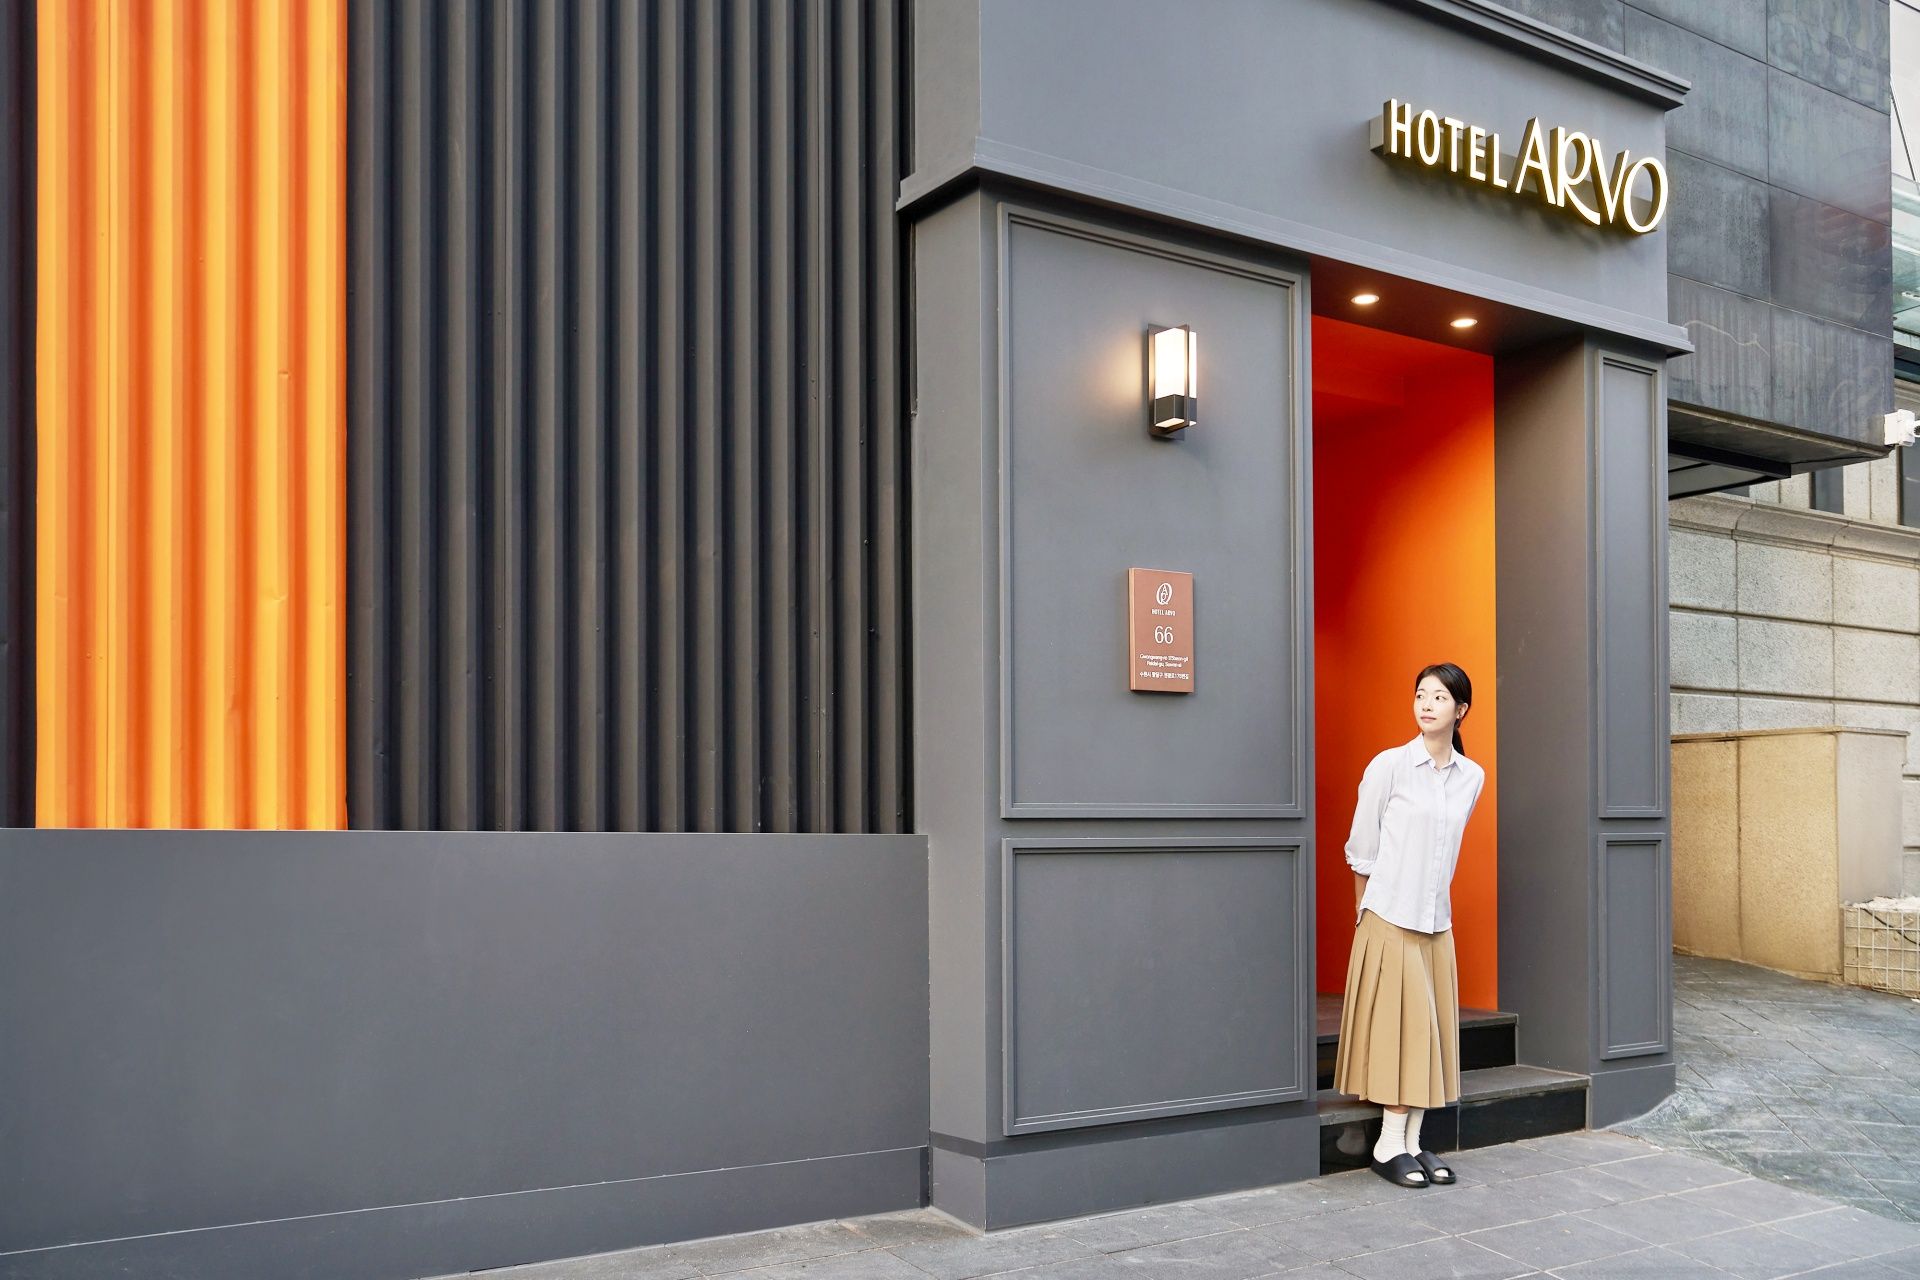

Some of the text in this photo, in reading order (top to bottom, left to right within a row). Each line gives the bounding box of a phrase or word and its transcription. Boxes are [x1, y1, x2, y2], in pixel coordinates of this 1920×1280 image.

[1385, 98, 1668, 233] HOTEL ARVO
[1151, 608, 1164, 616] HOTEL
[1154, 625, 1174, 644] 66
